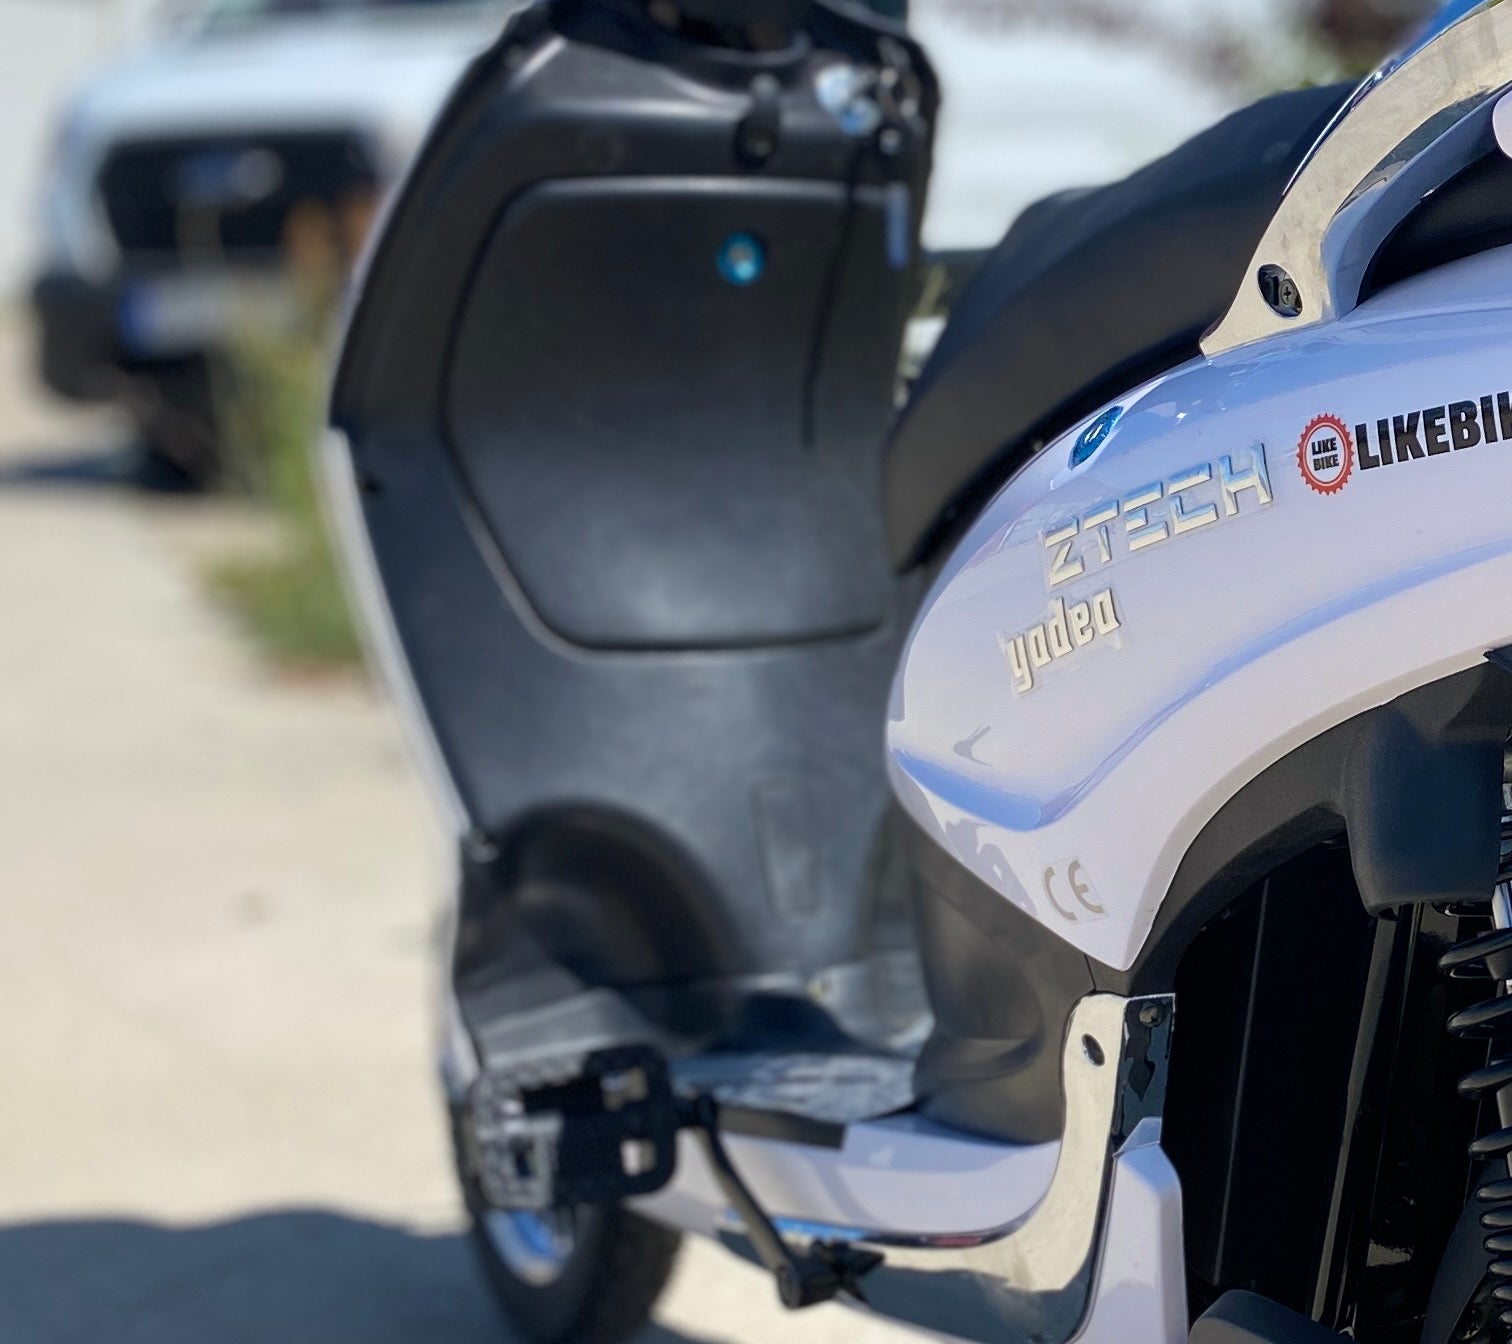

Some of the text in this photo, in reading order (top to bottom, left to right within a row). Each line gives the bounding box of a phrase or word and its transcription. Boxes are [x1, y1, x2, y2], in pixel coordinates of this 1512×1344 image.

[1311, 436, 1337, 455] LIKE
[1313, 454, 1339, 471] BIKE
[1043, 442, 1273, 586] ZTECH
